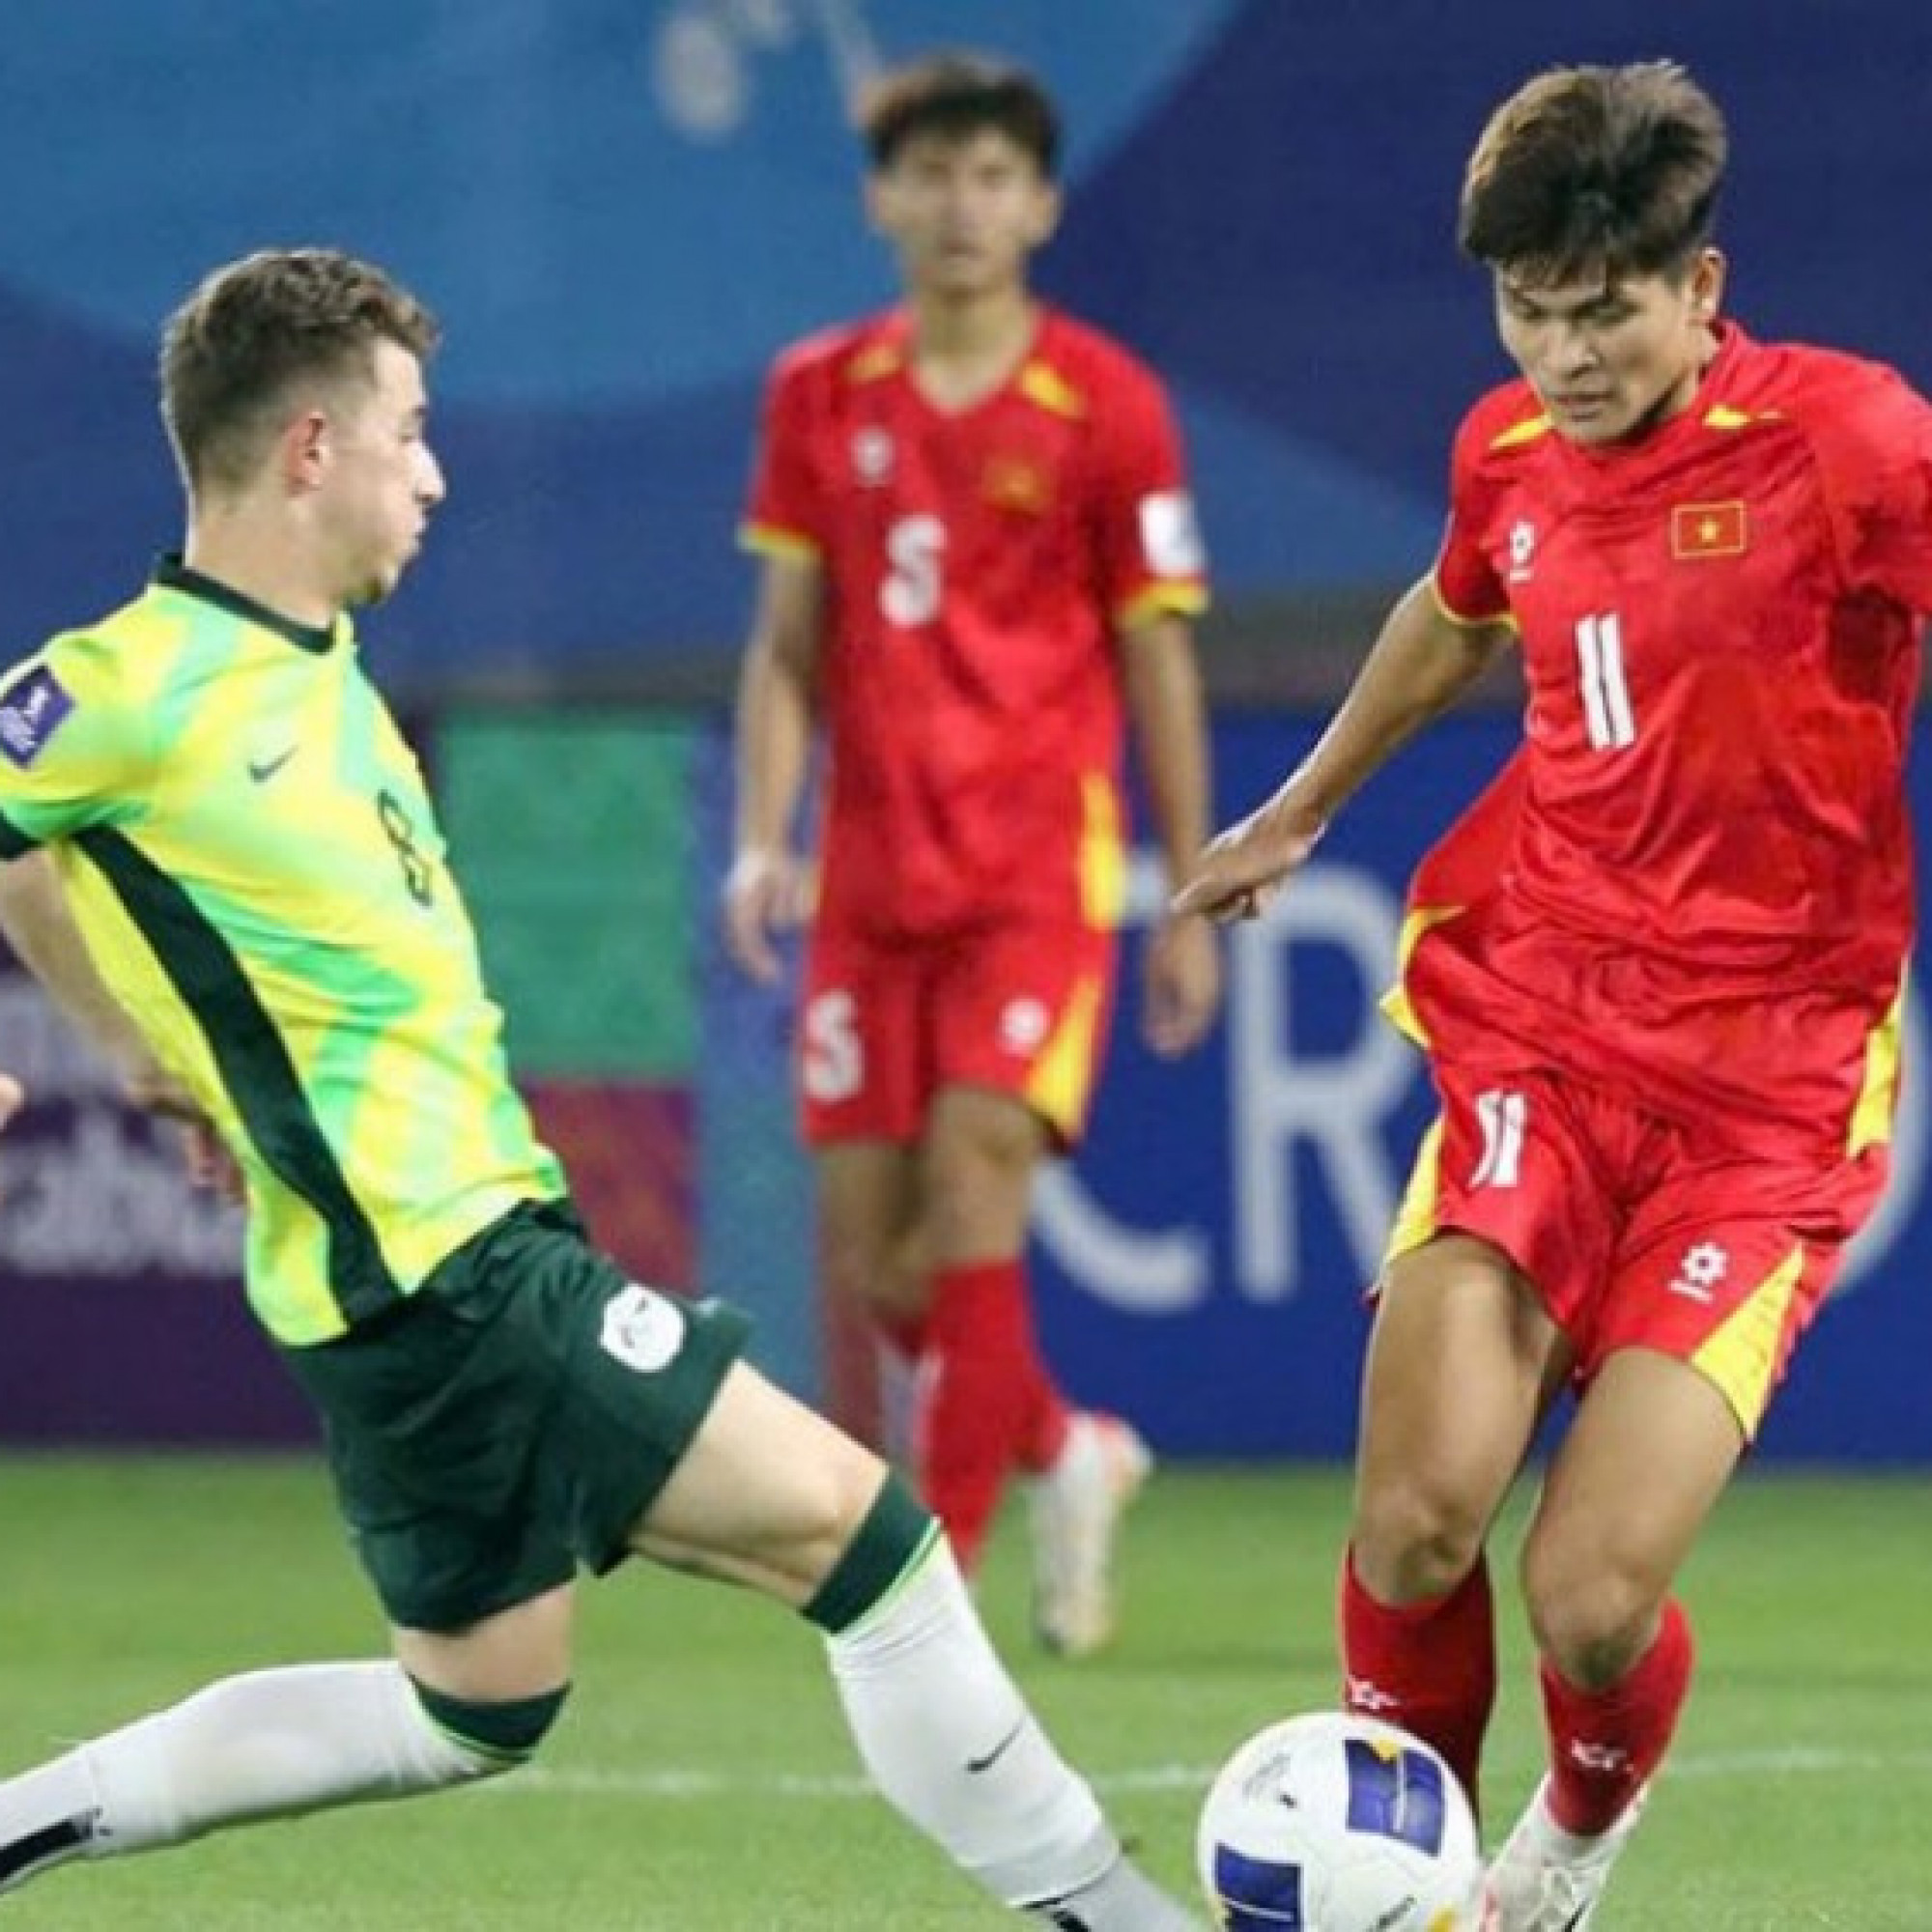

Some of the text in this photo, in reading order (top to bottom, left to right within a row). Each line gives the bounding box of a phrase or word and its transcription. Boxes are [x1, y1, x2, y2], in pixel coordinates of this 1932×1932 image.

[880, 516, 947, 628] 5
[1575, 611, 1635, 751] 11
[378, 788, 433, 906] 8
[803, 988, 865, 1102] 5
[1467, 1090, 1524, 1188] 11
